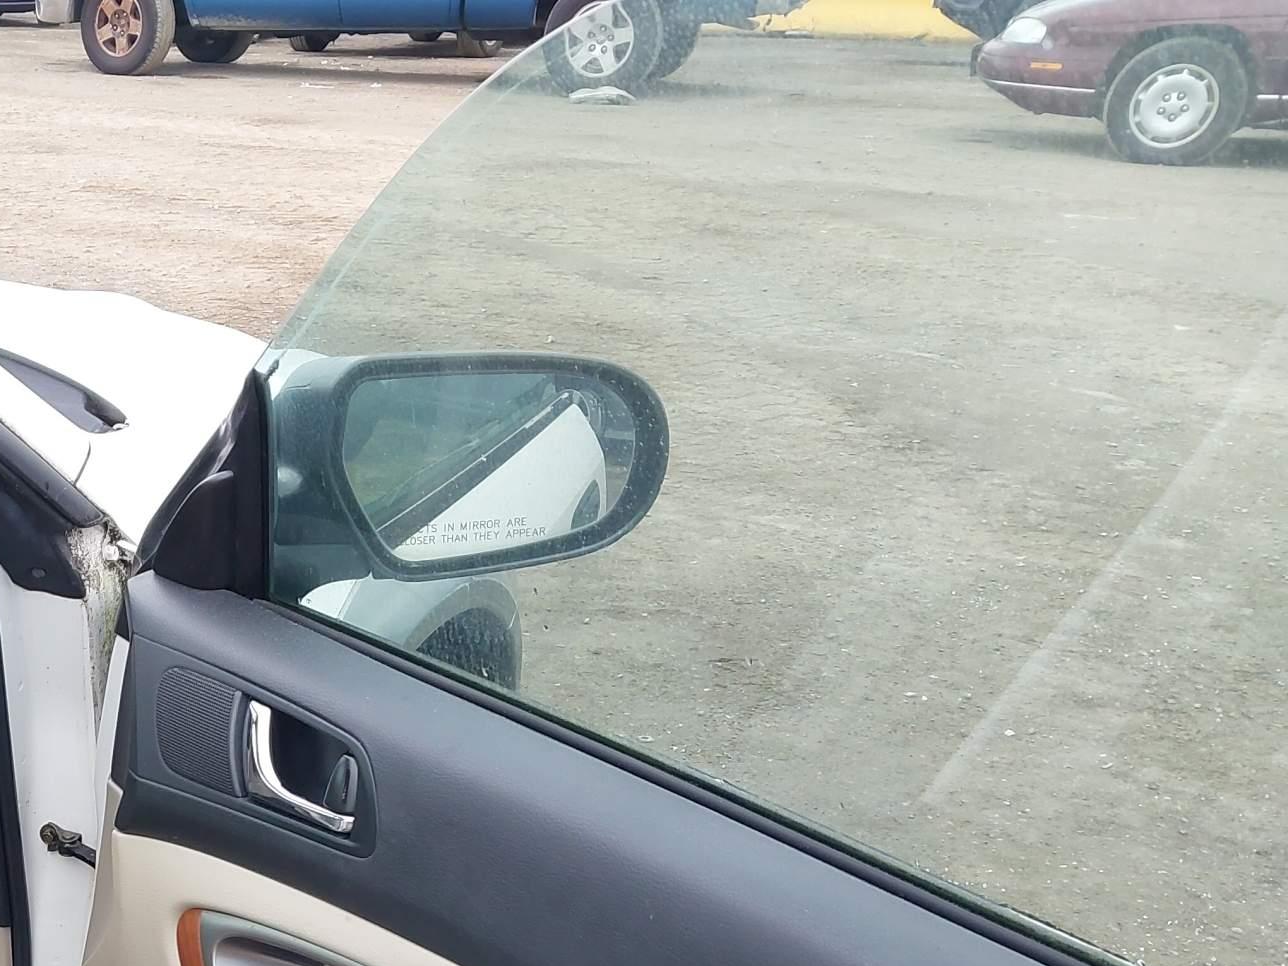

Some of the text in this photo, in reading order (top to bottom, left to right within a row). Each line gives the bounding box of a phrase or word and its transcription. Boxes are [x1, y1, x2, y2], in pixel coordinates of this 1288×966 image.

[443, 522, 455, 532] IN
[460, 519, 501, 530] MIRROR
[506, 517, 528, 527] ARE
[441, 533, 468, 544] THAN
[474, 530, 500, 541] THEY
[506, 527, 546, 538] APPEAR
